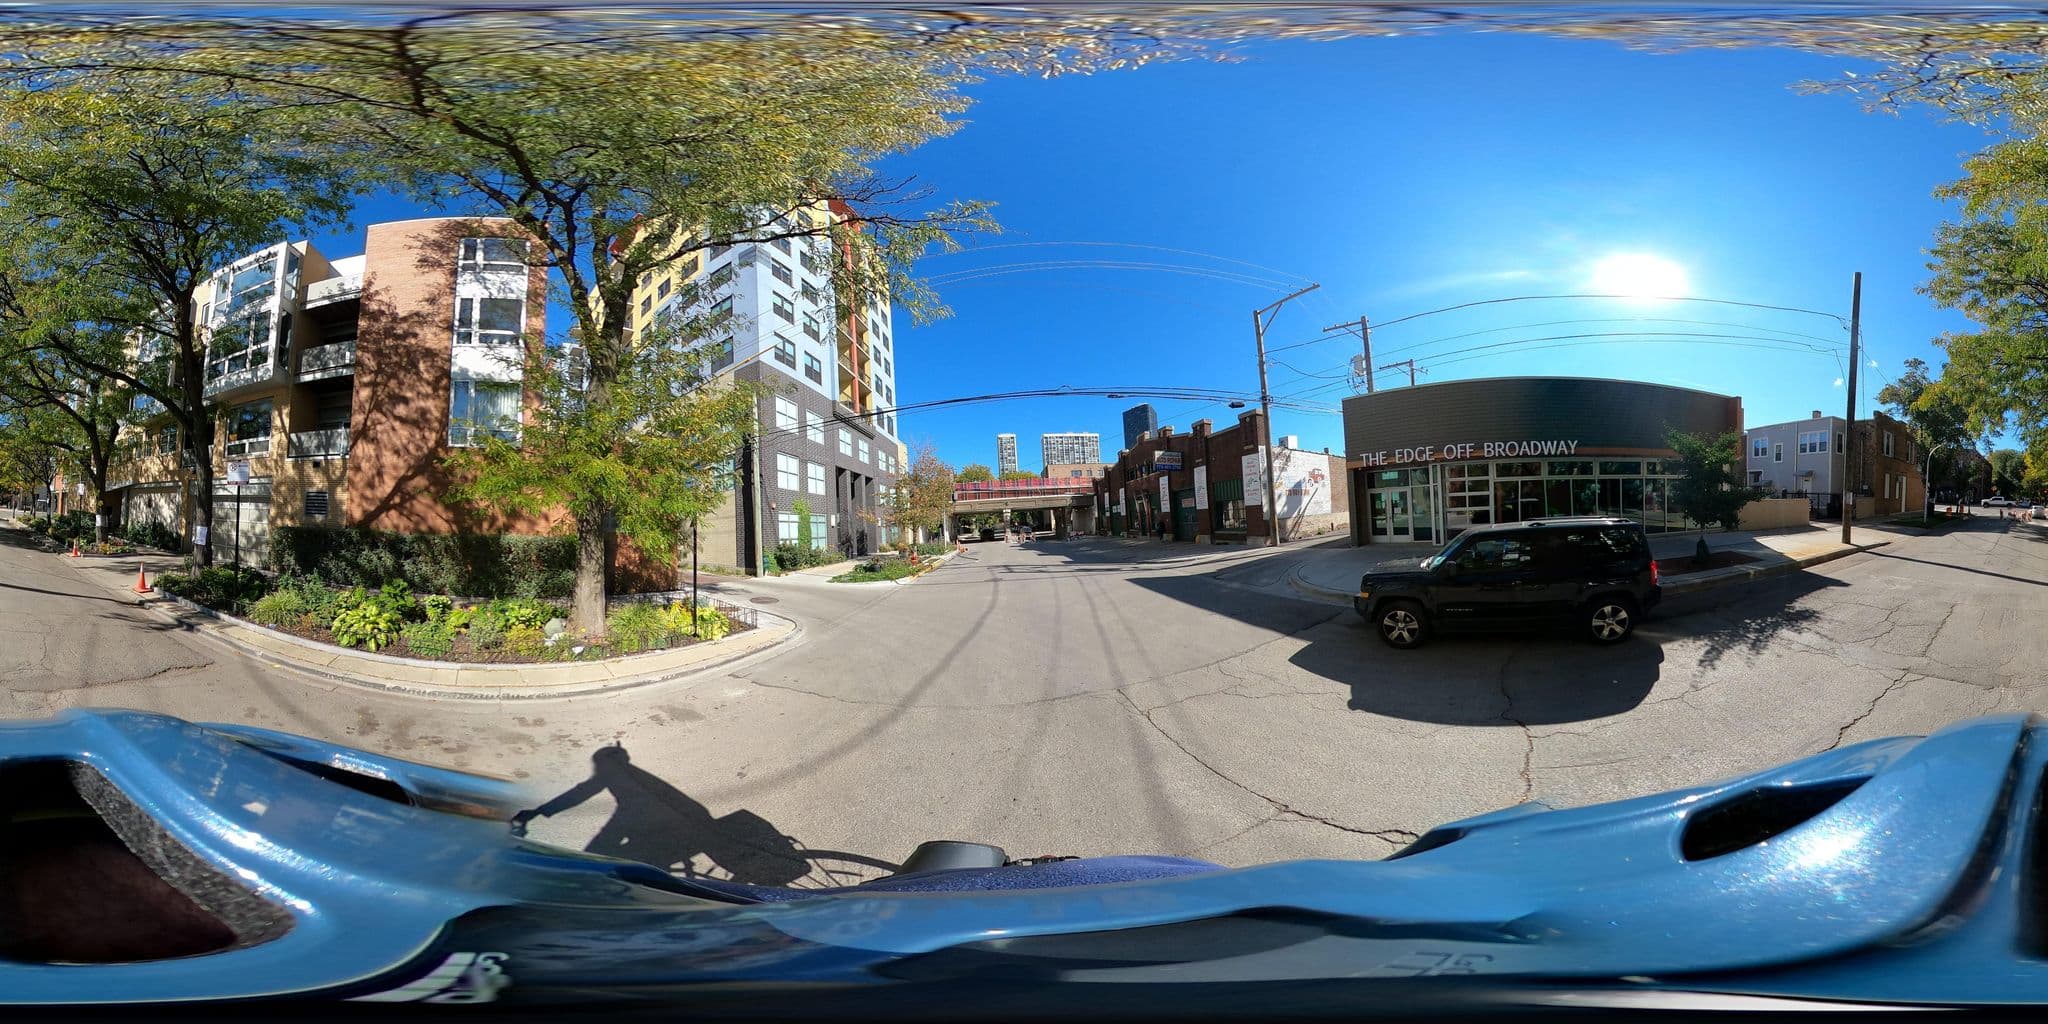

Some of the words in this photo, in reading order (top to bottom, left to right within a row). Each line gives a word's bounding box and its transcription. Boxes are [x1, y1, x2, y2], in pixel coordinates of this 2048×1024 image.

[1360, 451, 1388, 467] THE
[1395, 446, 1434, 464] EDGE
[1443, 443, 1475, 459] OFF
[1483, 440, 1578, 457] BROADWAY
